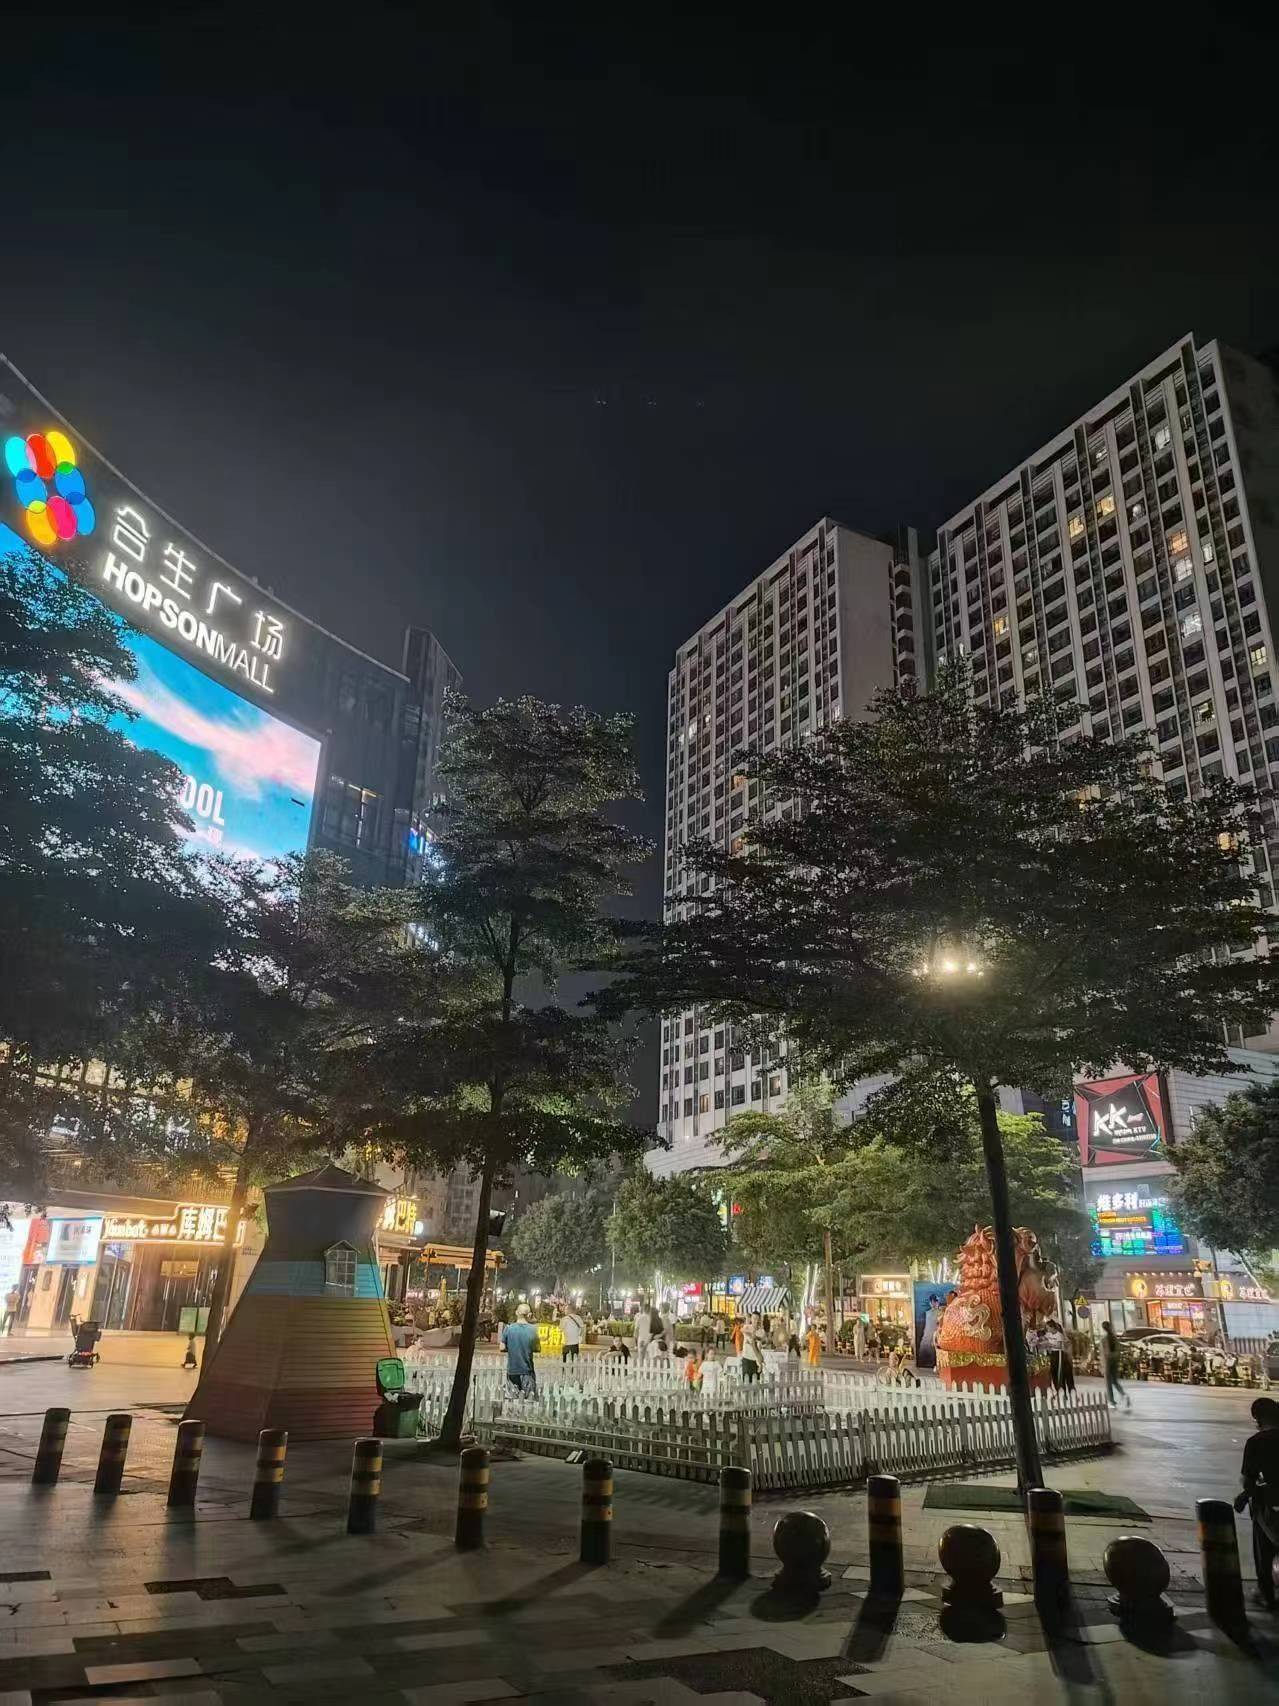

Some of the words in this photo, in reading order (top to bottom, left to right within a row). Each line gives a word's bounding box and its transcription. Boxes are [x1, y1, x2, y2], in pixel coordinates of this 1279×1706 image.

[102, 551, 275, 694] HOPSONMALL
[113, 505, 284, 660] 合生广场
[178, 1207, 241, 1242] 库姆巴
